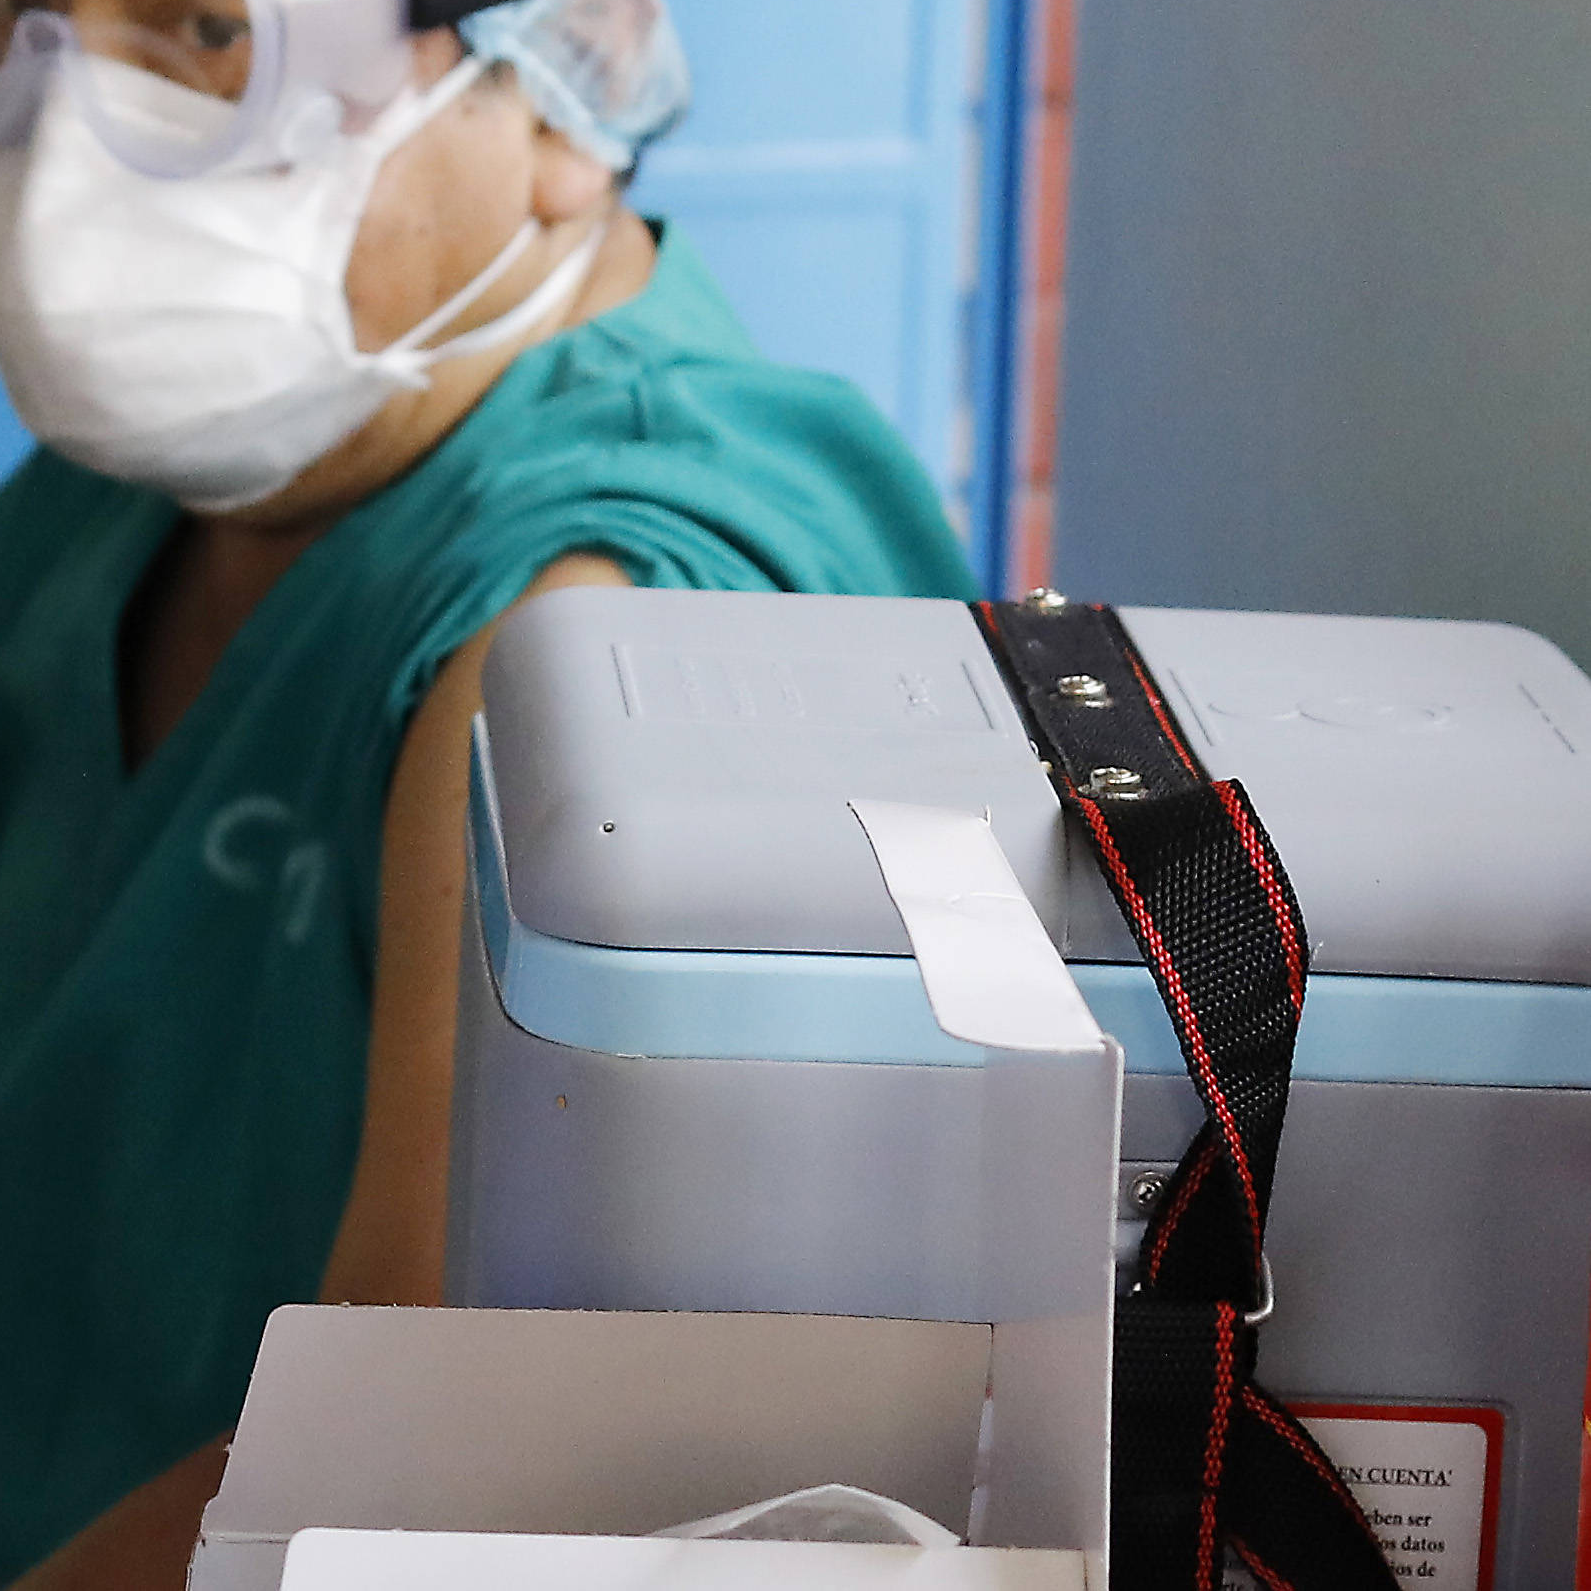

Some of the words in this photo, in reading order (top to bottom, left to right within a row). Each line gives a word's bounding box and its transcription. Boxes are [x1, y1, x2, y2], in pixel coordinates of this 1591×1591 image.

[1408, 1514, 1432, 1527] ser
[1401, 1535, 1446, 1551] datos
[1417, 1560, 1436, 1577] de
